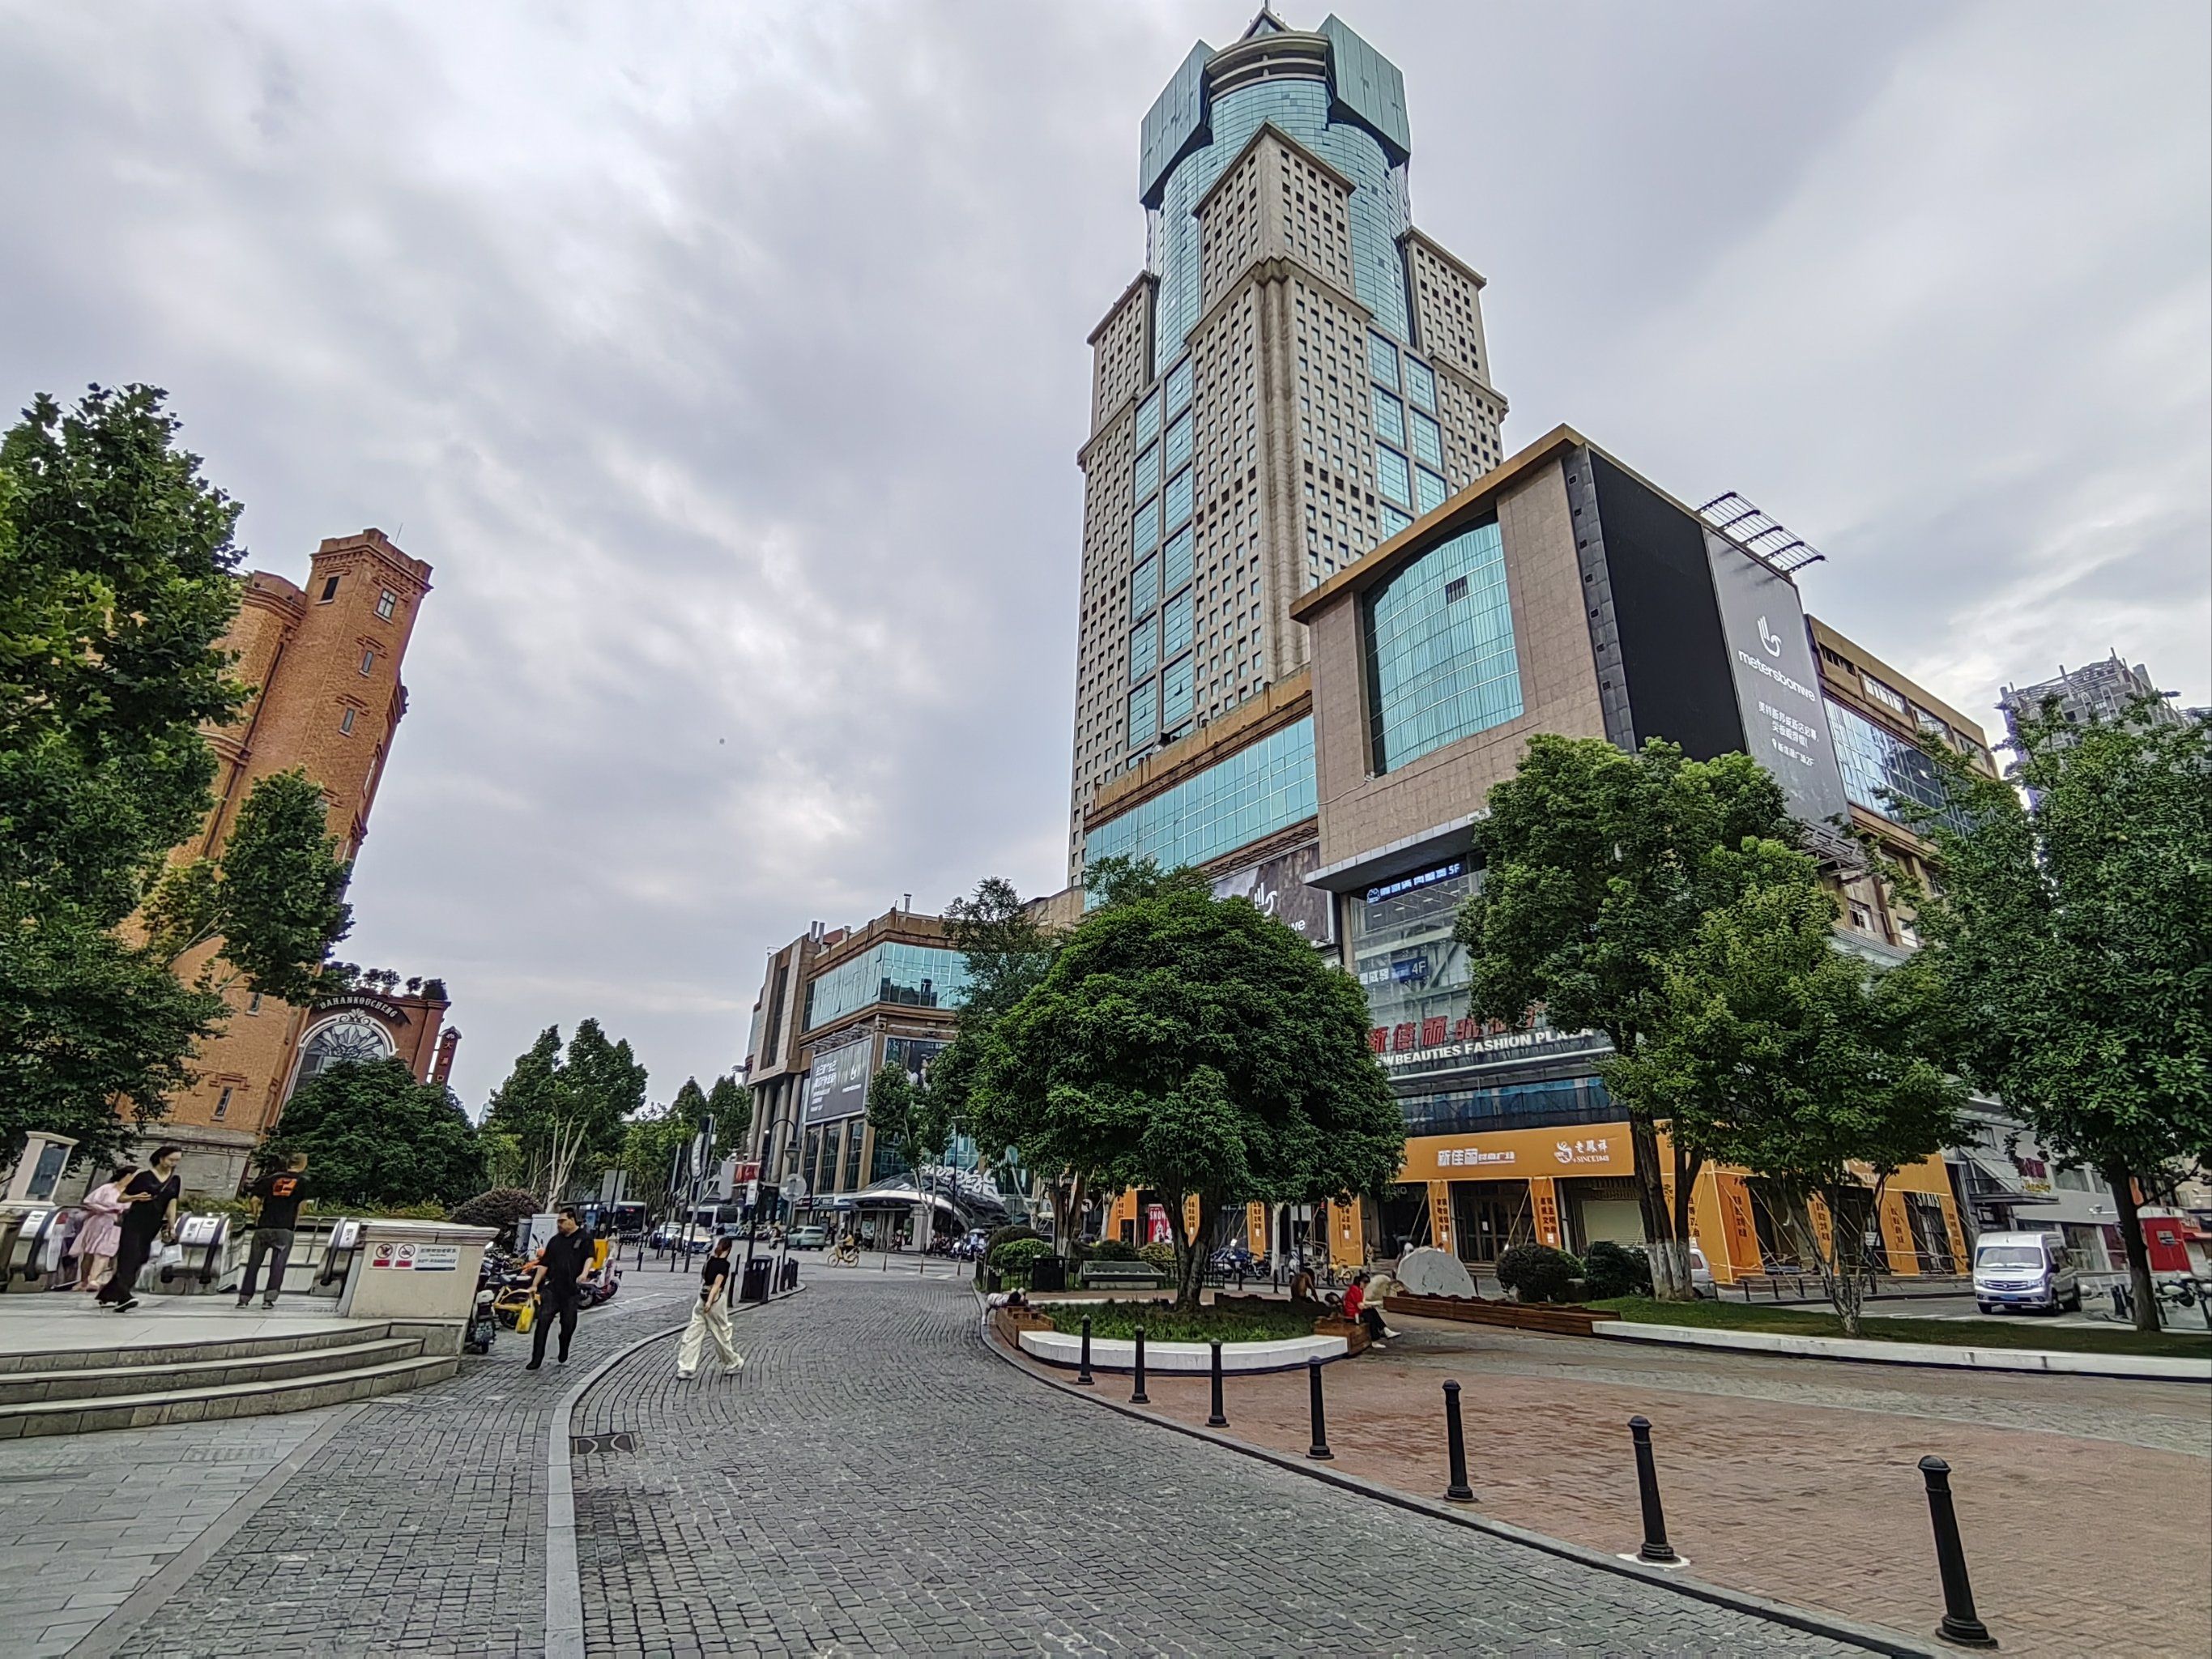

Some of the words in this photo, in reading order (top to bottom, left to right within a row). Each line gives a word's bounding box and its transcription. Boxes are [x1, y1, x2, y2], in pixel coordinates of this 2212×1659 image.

[1412, 961, 1426, 975] 4F
[319, 996, 399, 1017] DAHANKOUCHENG
[1464, 1034, 1532, 1055] FASHION
[1535, 1028, 1594, 1044] PLAA
